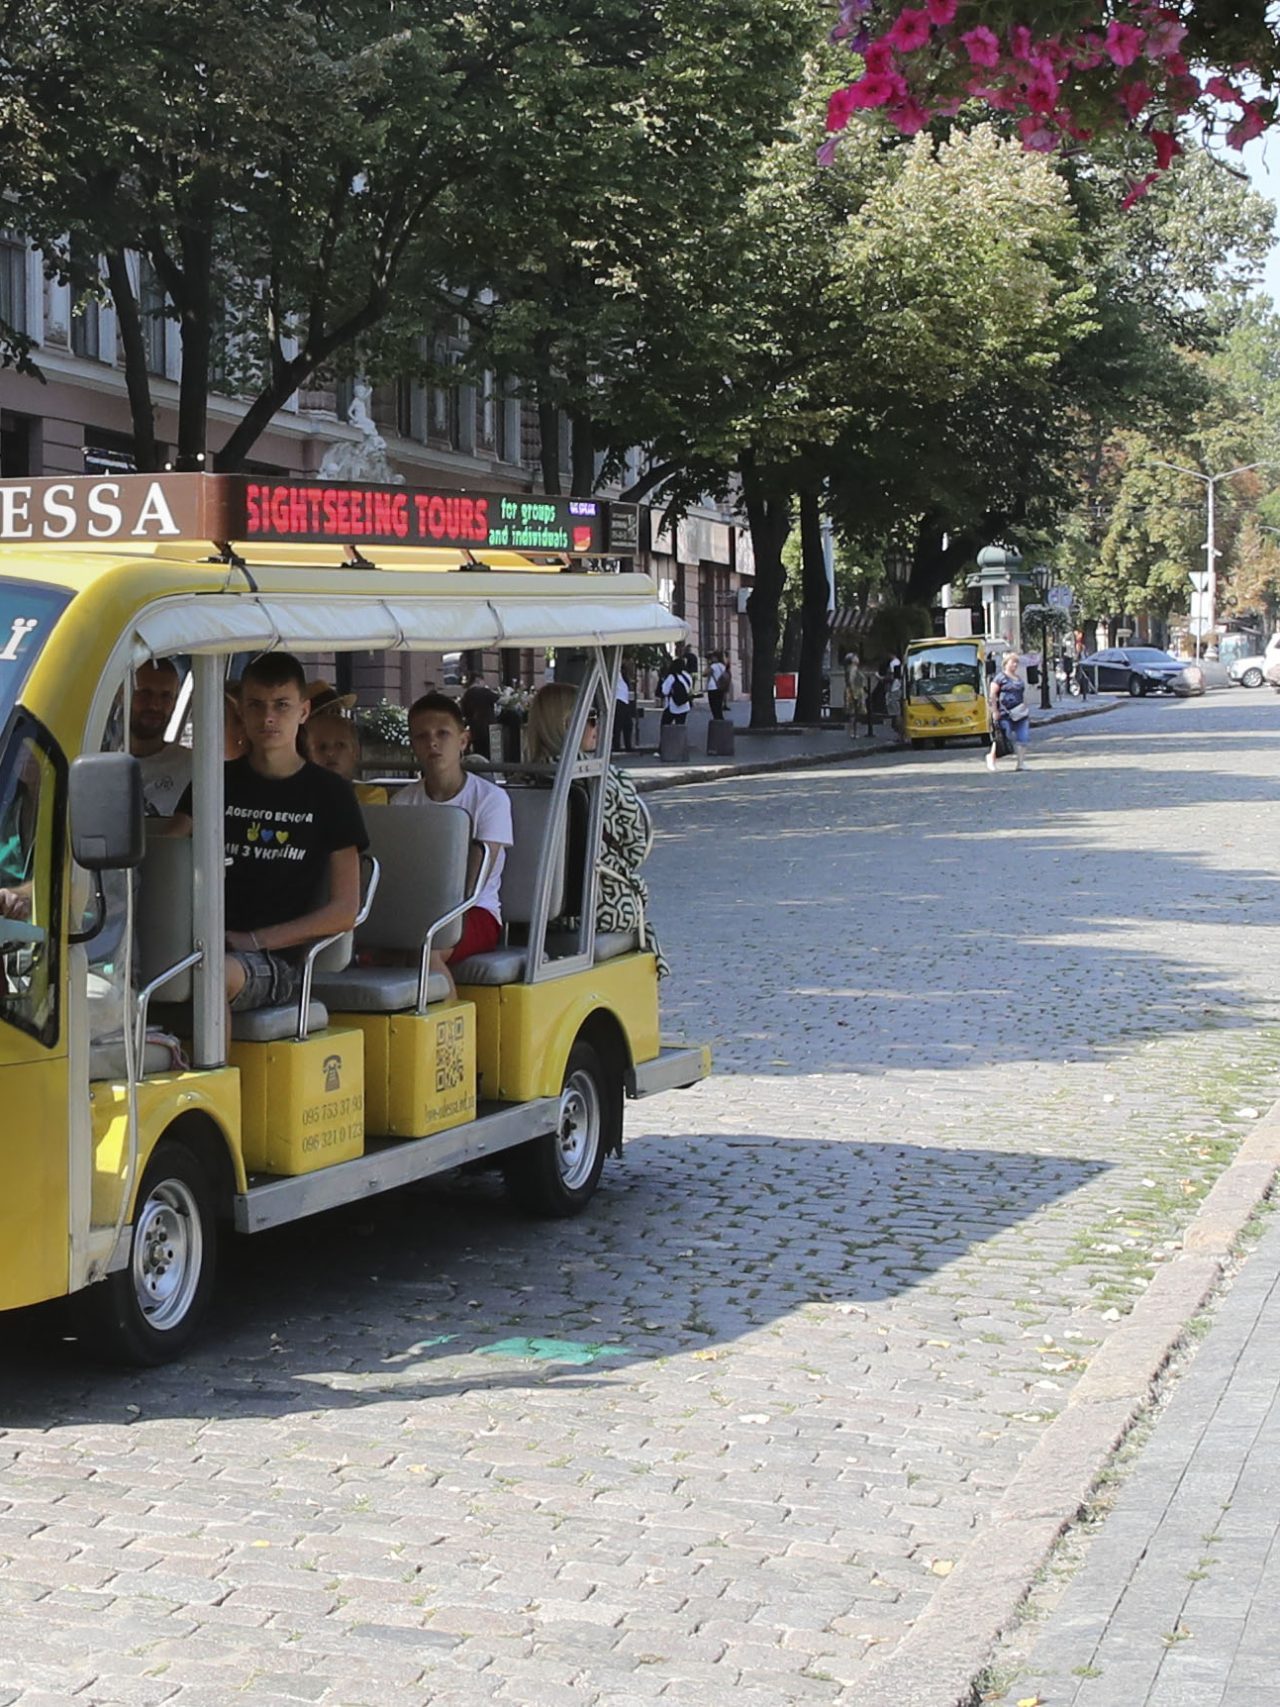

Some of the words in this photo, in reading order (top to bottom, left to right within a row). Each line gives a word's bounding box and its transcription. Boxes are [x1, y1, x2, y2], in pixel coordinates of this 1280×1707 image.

[246, 484, 409, 537] SIGHTSEEING
[414, 495, 488, 541] TOURS
[501, 498, 517, 519] for
[521, 503, 556, 525] groups
[488, 525, 508, 546] and
[512, 526, 568, 549] individuals
